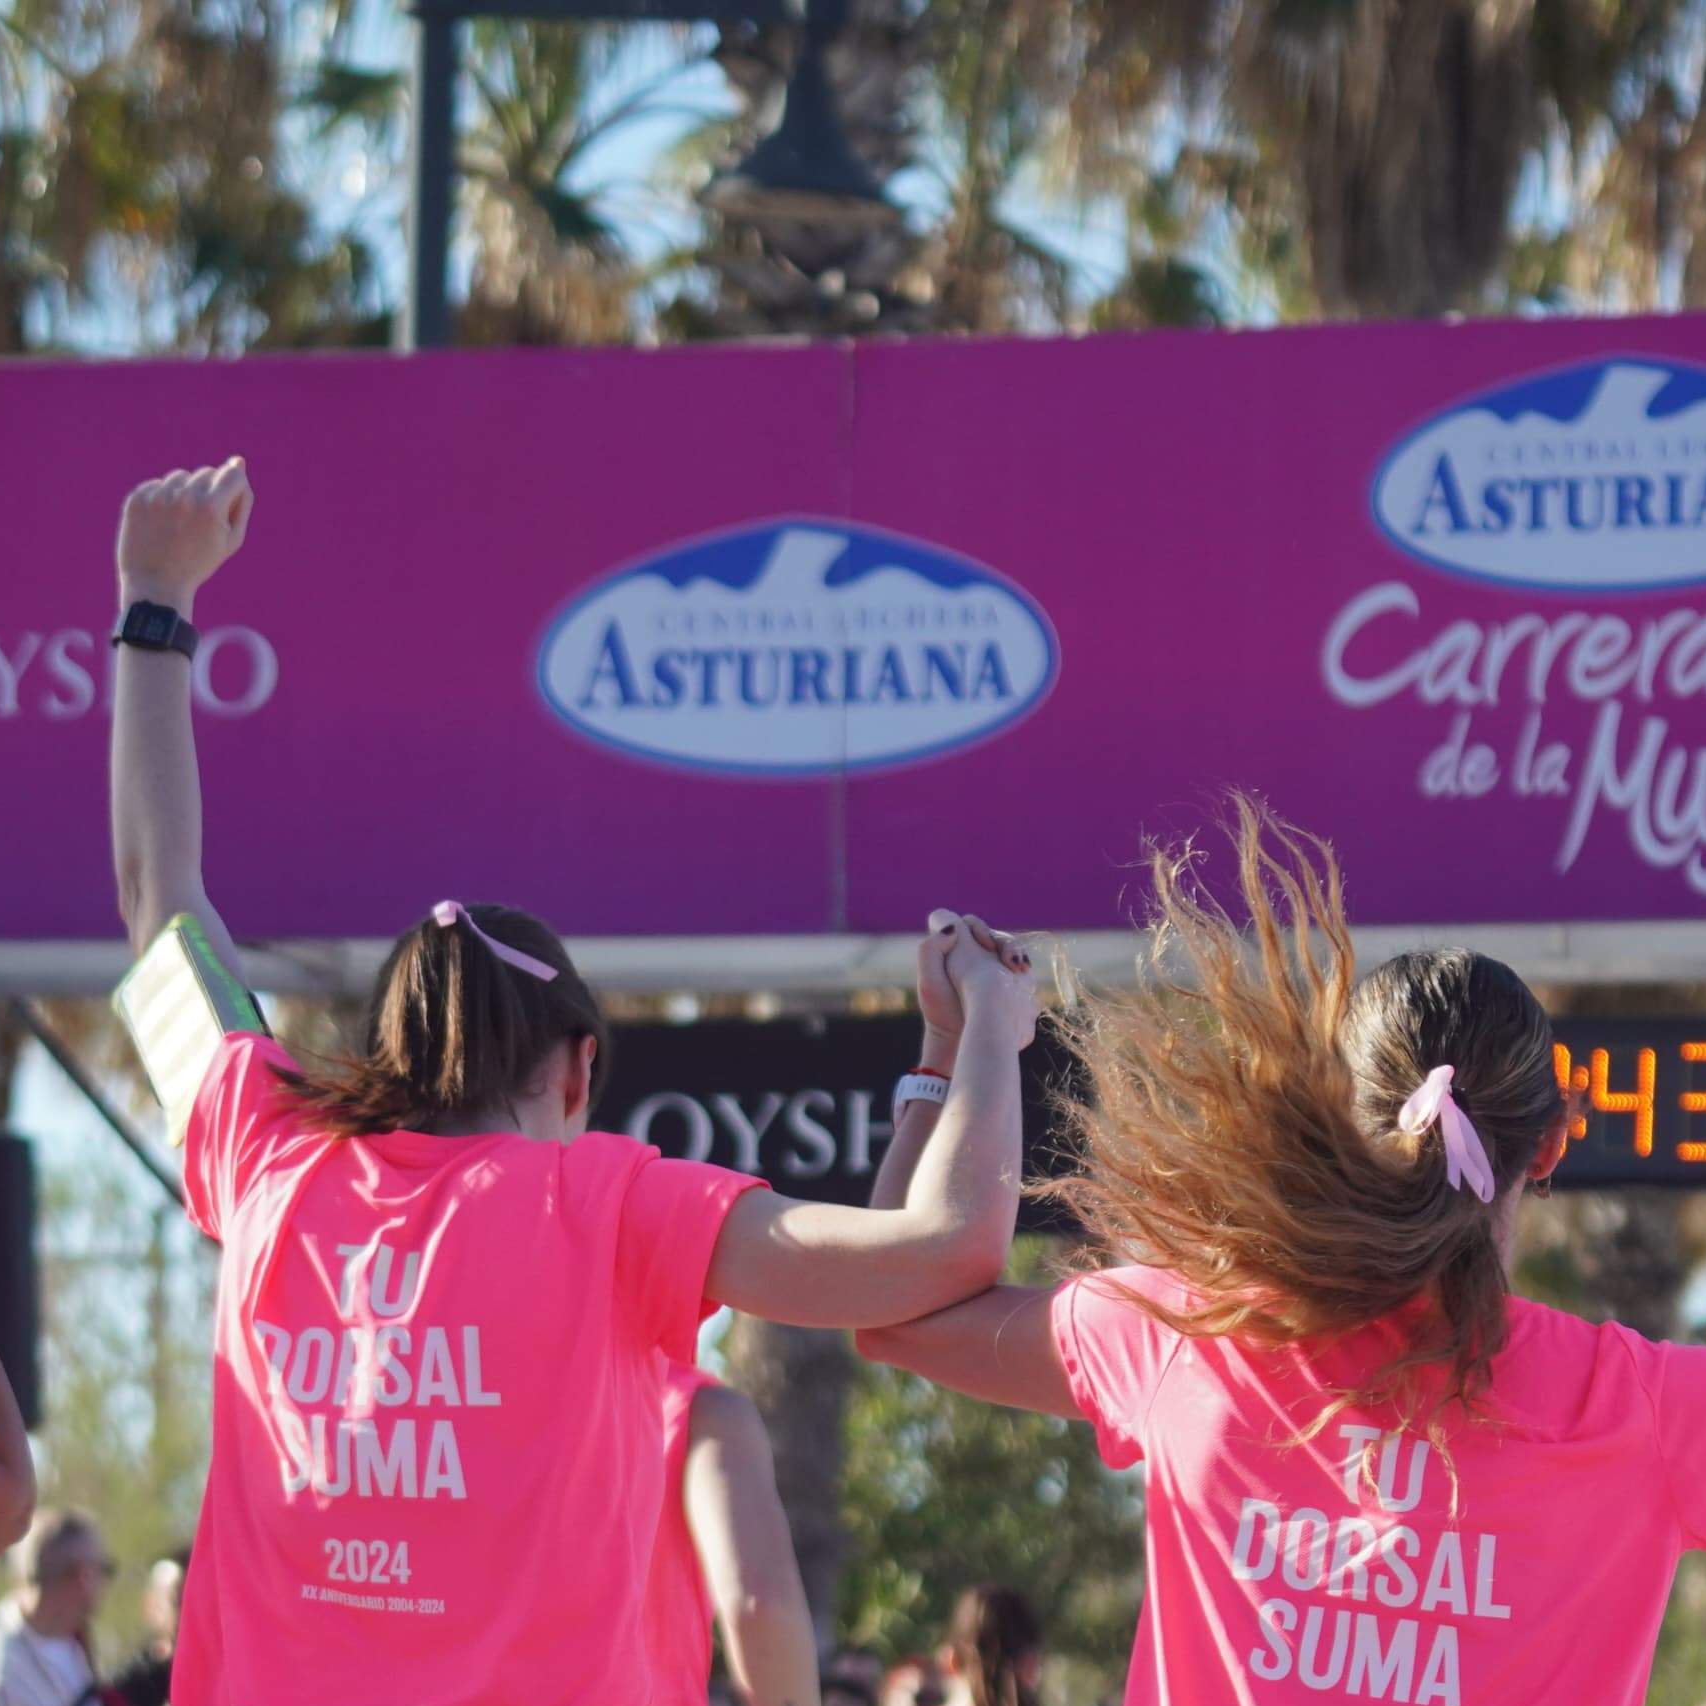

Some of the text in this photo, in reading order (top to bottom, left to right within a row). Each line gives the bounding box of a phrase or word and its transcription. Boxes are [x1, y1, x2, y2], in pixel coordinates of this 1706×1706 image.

[581, 614, 1014, 708] ASTURIANA
[1420, 711, 1499, 796] de
[1514, 704, 1569, 794] la
[336, 1243, 421, 1318] TU
[253, 1319, 502, 1407] DORSAL
[279, 1413, 467, 1500] SUMA
[1339, 1424, 1430, 1512] TU
[324, 1538, 412, 1585] 2024
[1232, 1497, 1511, 1619] DORSAL
